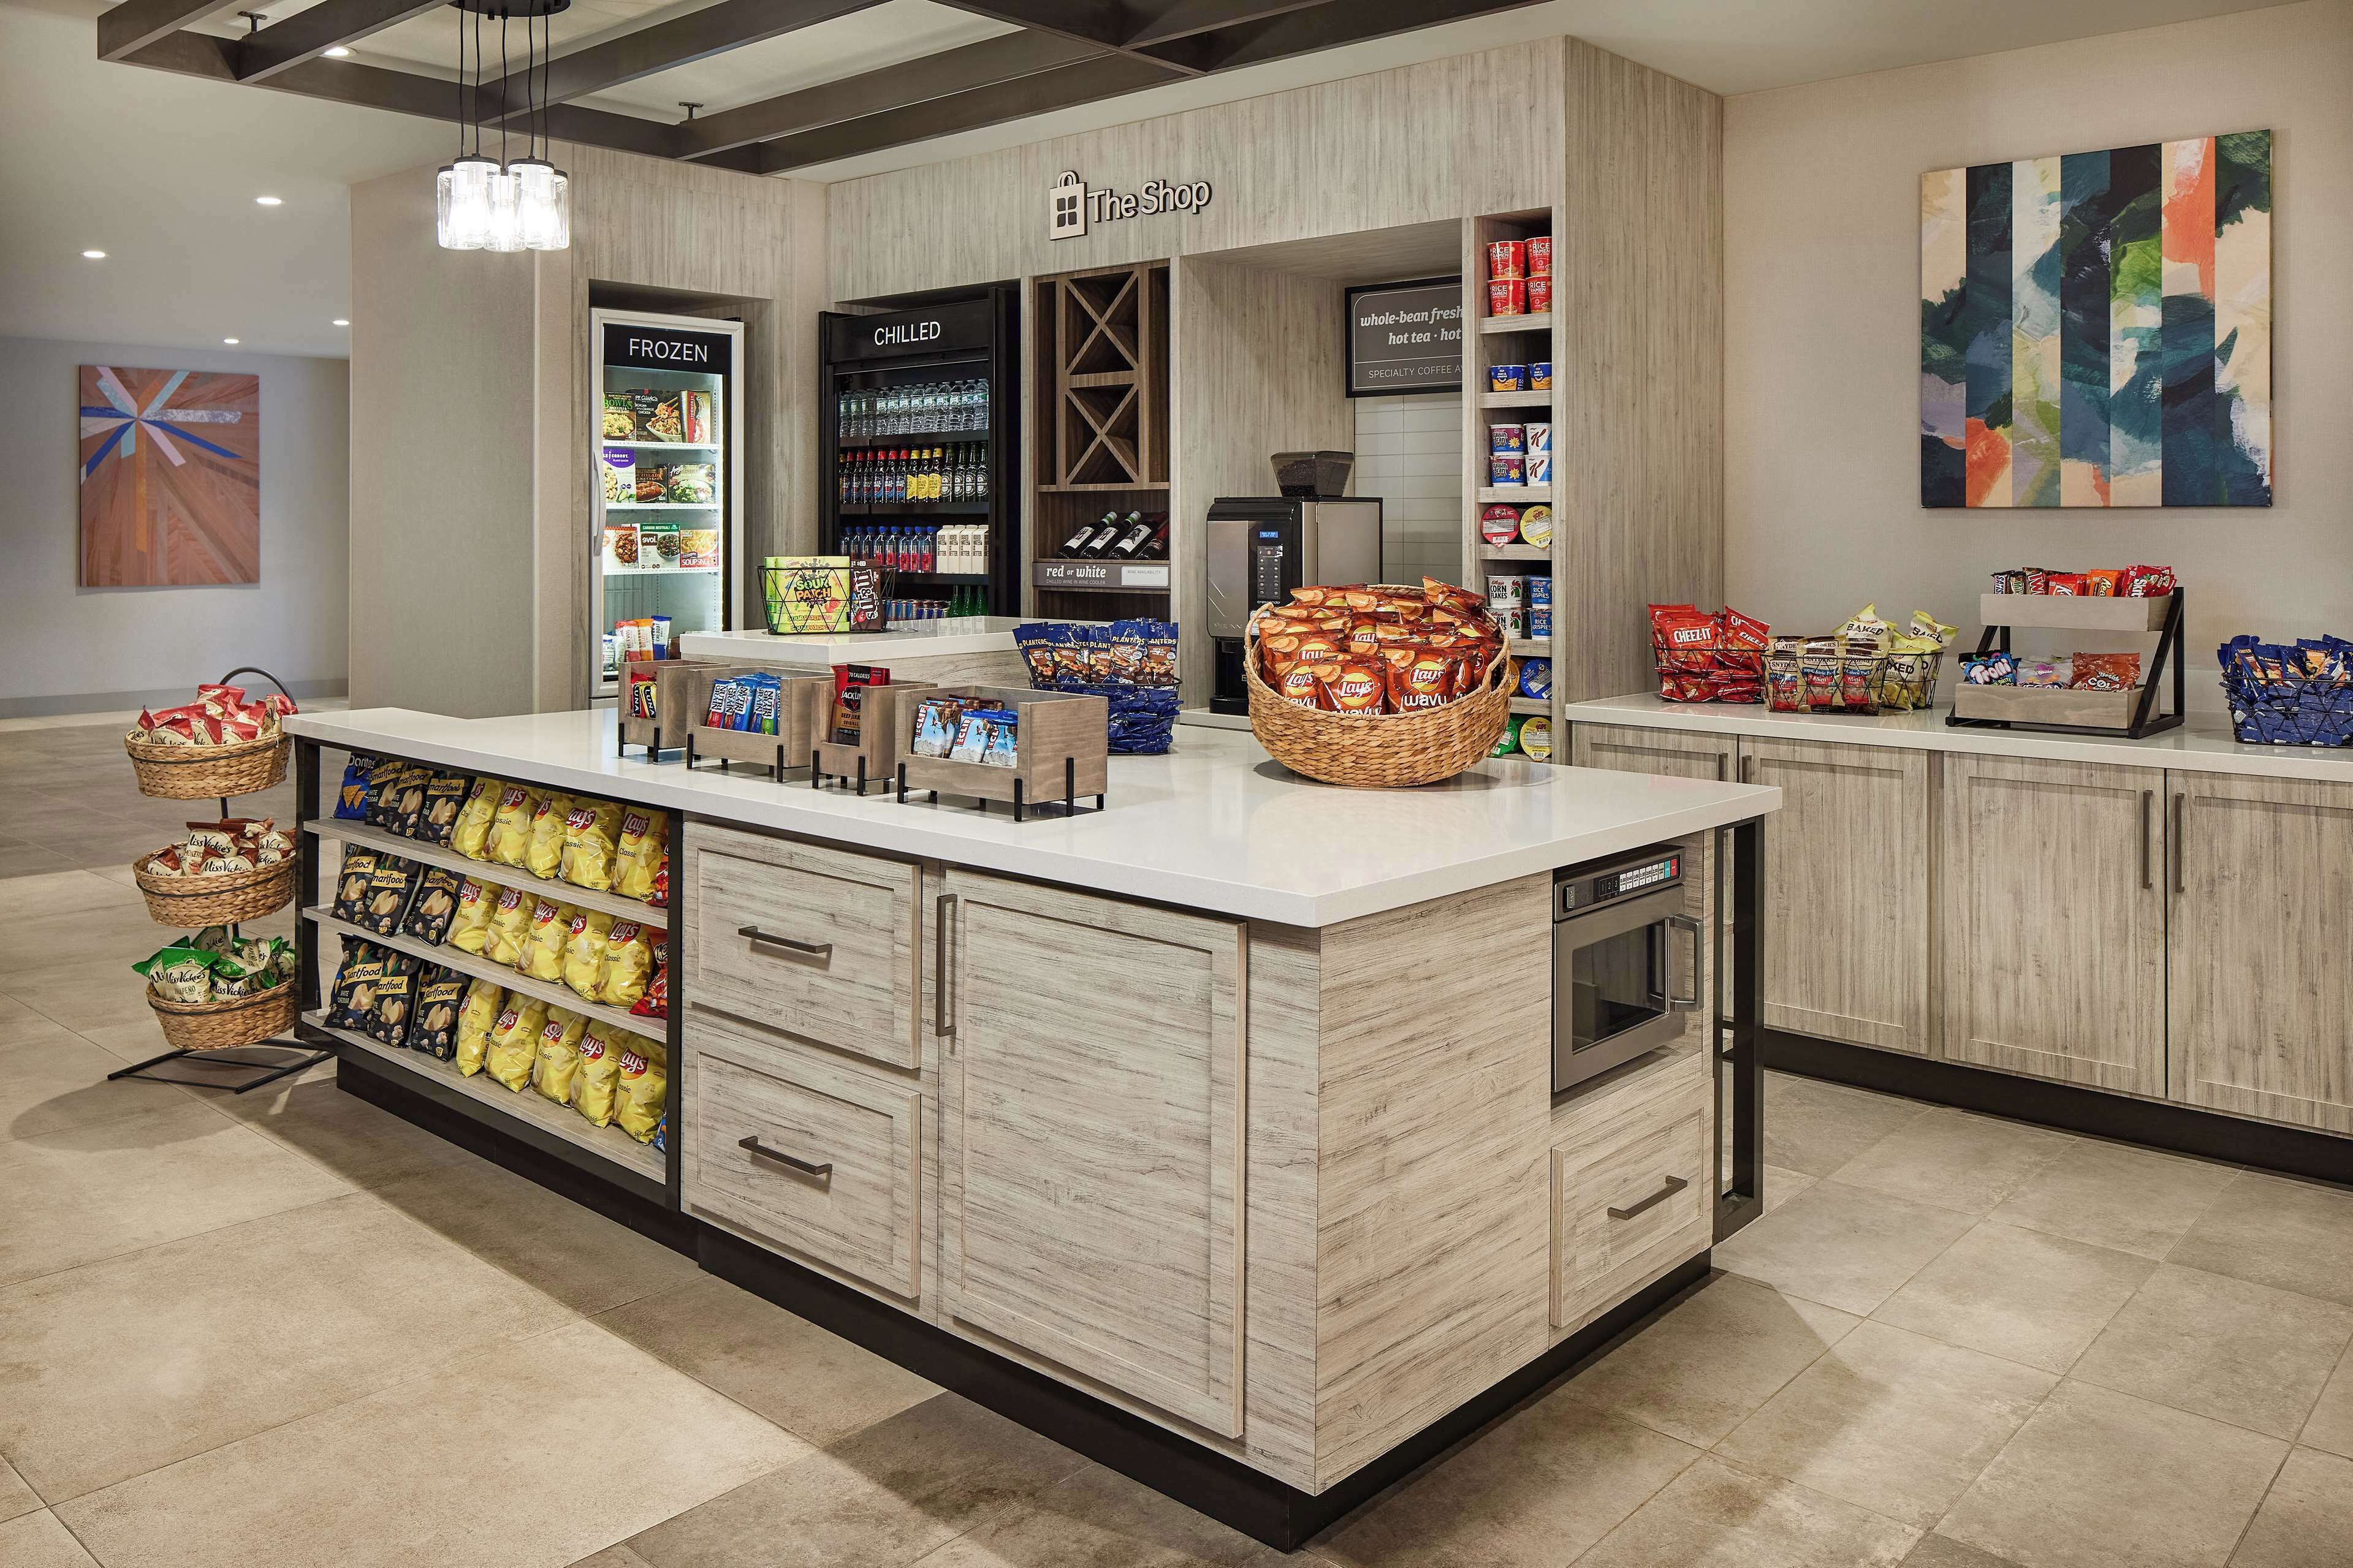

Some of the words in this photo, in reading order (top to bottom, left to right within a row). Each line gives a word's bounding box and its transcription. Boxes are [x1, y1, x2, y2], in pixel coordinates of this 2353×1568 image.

[1087, 188, 1138, 222] The
[1141, 180, 1212, 214] Shop
[1360, 311, 1429, 327] whole-bean
[875, 321, 940, 346] CHILLED
[1388, 333, 1408, 345] hot
[1411, 331, 1431, 343] tea
[1440, 328, 1462, 341] hot
[629, 338, 707, 362] FROZEN
[1369, 368, 1415, 379] SPECIALTY
[1418, 365, 1452, 375] COFFEE
[603, 400, 633, 409] BOWLS
[1046, 565, 1064, 577] red
[1076, 566, 1106, 578] white
[796, 578, 829, 590] SOUR
[795, 588, 832, 603] PATCH
[1674, 628, 1711, 643] CHEEZ-IT
[1847, 624, 1884, 635] BAKED
[1022, 638, 1047, 647] PLANTERS
[1412, 668, 1444, 684] Lay's
[1970, 659, 2012, 684] Trolli
[1287, 672, 1315, 688] Lay's
[2088, 678, 2120, 689] COLA
[841, 691, 854, 700] JACK
[1340, 681, 1374, 699] Lay's
[644, 689, 655, 716] LUNA
[717, 686, 727, 710] NUTRI
[739, 686, 749, 711] NUTRI
[349, 755, 376, 769] Doritos
[622, 813, 650, 838] Lay's
[619, 847, 637, 858] Classic
[203, 862, 222, 872] Miss
[609, 921, 639, 942] Lay's
[180, 969, 207, 984] Vickie's
